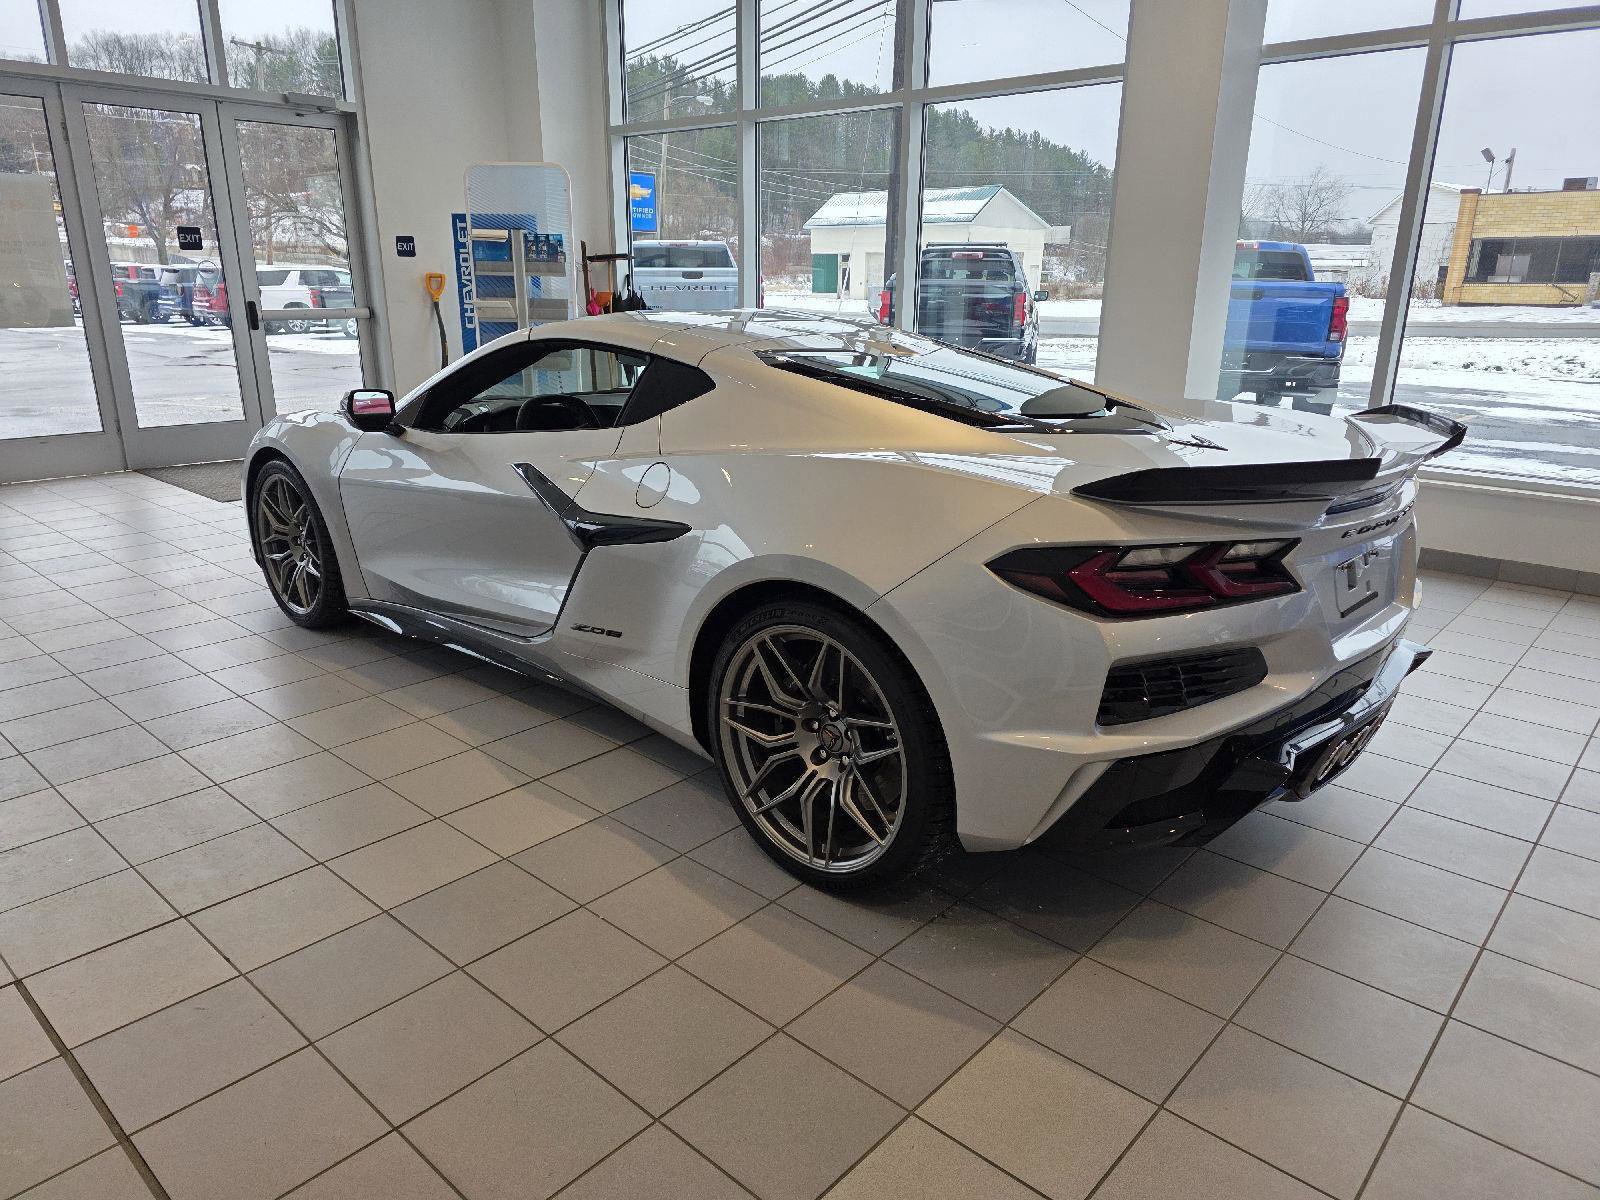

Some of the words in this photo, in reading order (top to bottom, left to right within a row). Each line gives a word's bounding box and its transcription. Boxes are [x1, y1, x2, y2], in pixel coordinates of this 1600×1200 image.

[179, 233, 201, 243] EXIT
[397, 242, 414, 251] EXIT
[456, 219, 476, 329] CHEVROLET
